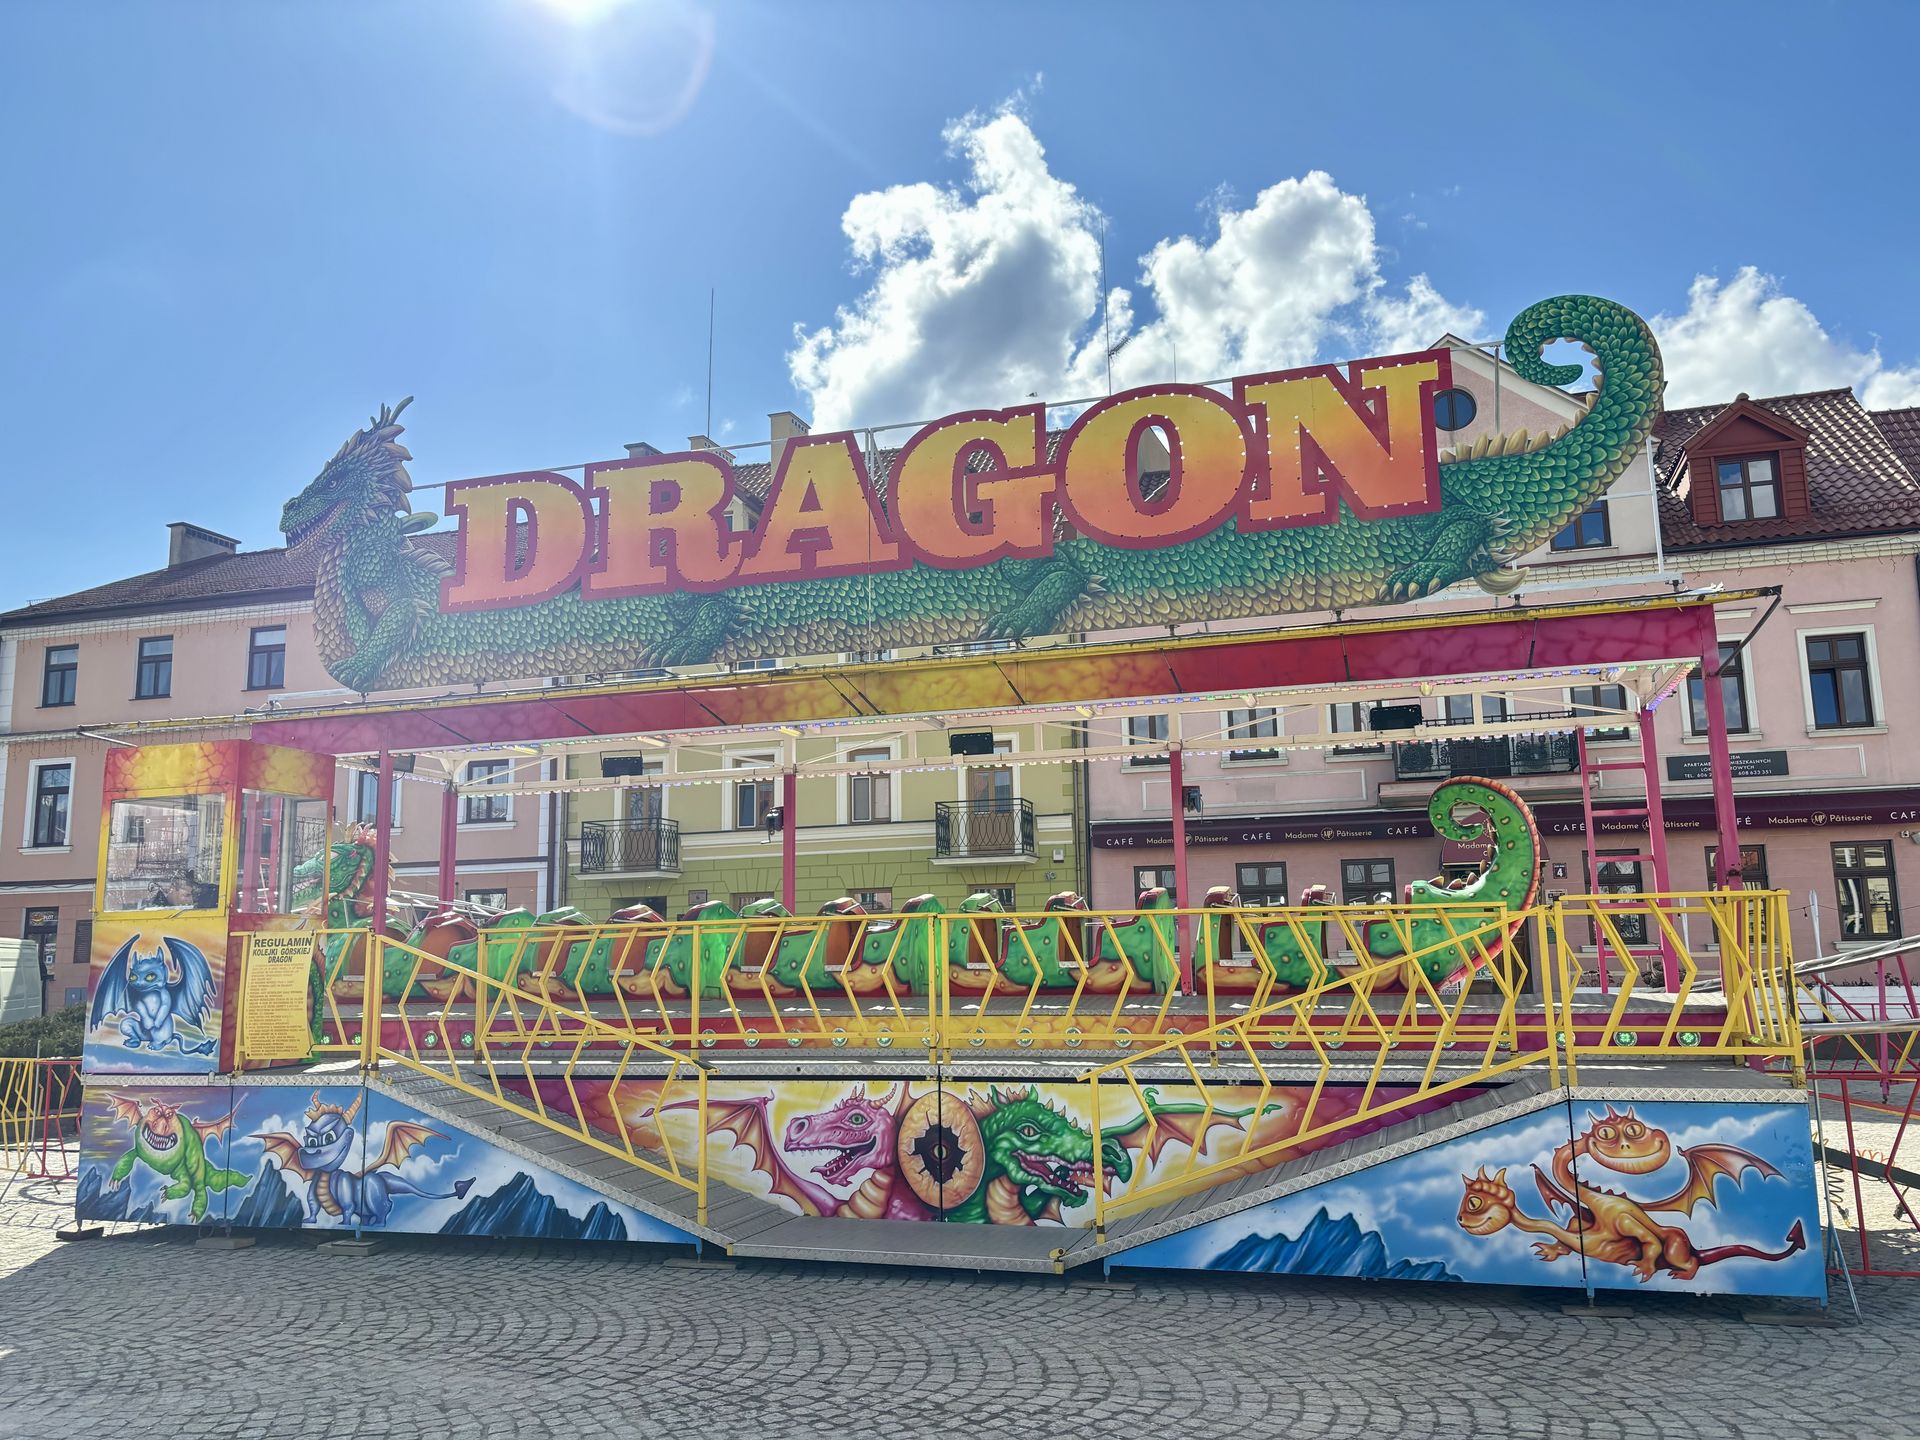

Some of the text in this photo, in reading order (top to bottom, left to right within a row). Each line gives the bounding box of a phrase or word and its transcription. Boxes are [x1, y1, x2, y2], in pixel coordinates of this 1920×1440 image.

[440, 347, 1452, 612] DRAGON
[1554, 822, 1586, 832] CAFÉ
[1601, 822, 1639, 831] Madame
[1663, 820, 1700, 828] âtisserie
[1736, 815, 1752, 825] FÉ
[1768, 815, 1808, 824] Madame
[1829, 813, 1873, 822] Pâtisserie
[1889, 811, 1918, 820] CAF
[1106, 838, 1134, 846] CAFÉ
[1146, 837, 1174, 845] Madam
[1194, 834, 1229, 843] Pâtisserie
[1242, 832, 1272, 841] CAFÉ
[1336, 829, 1373, 837] Pâtisserie
[1387, 826, 1418, 835] CAFÉ
[1556, 867, 1564, 877] 4
[254, 938, 312, 947] REGULAMIN
